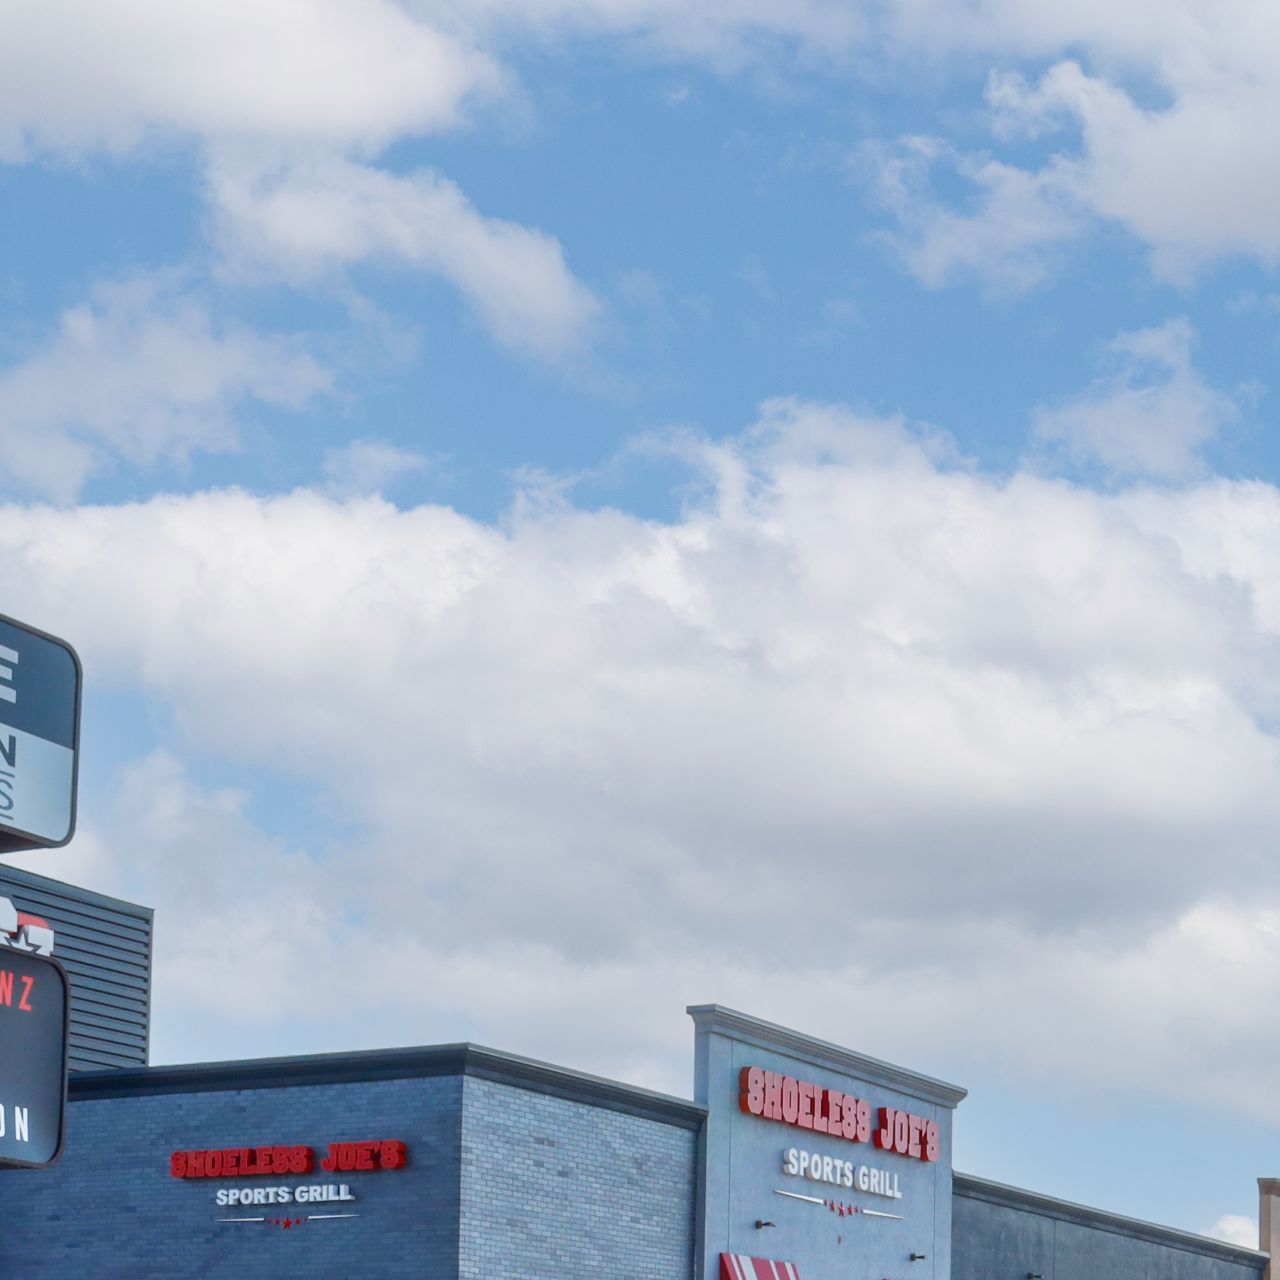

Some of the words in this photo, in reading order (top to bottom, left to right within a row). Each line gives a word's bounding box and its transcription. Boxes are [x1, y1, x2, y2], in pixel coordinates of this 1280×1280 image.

[739, 1066, 872, 1143] SHOELESS
[873, 1107, 940, 1162] JOE'S
[170, 1144, 315, 1178] SHOELESS
[320, 1139, 407, 1172] JOE'S
[783, 1147, 854, 1188] SPORTS
[855, 1165, 902, 1199] GRILL
[216, 1186, 291, 1205] SPORTS
[295, 1184, 355, 1203] GRILL
